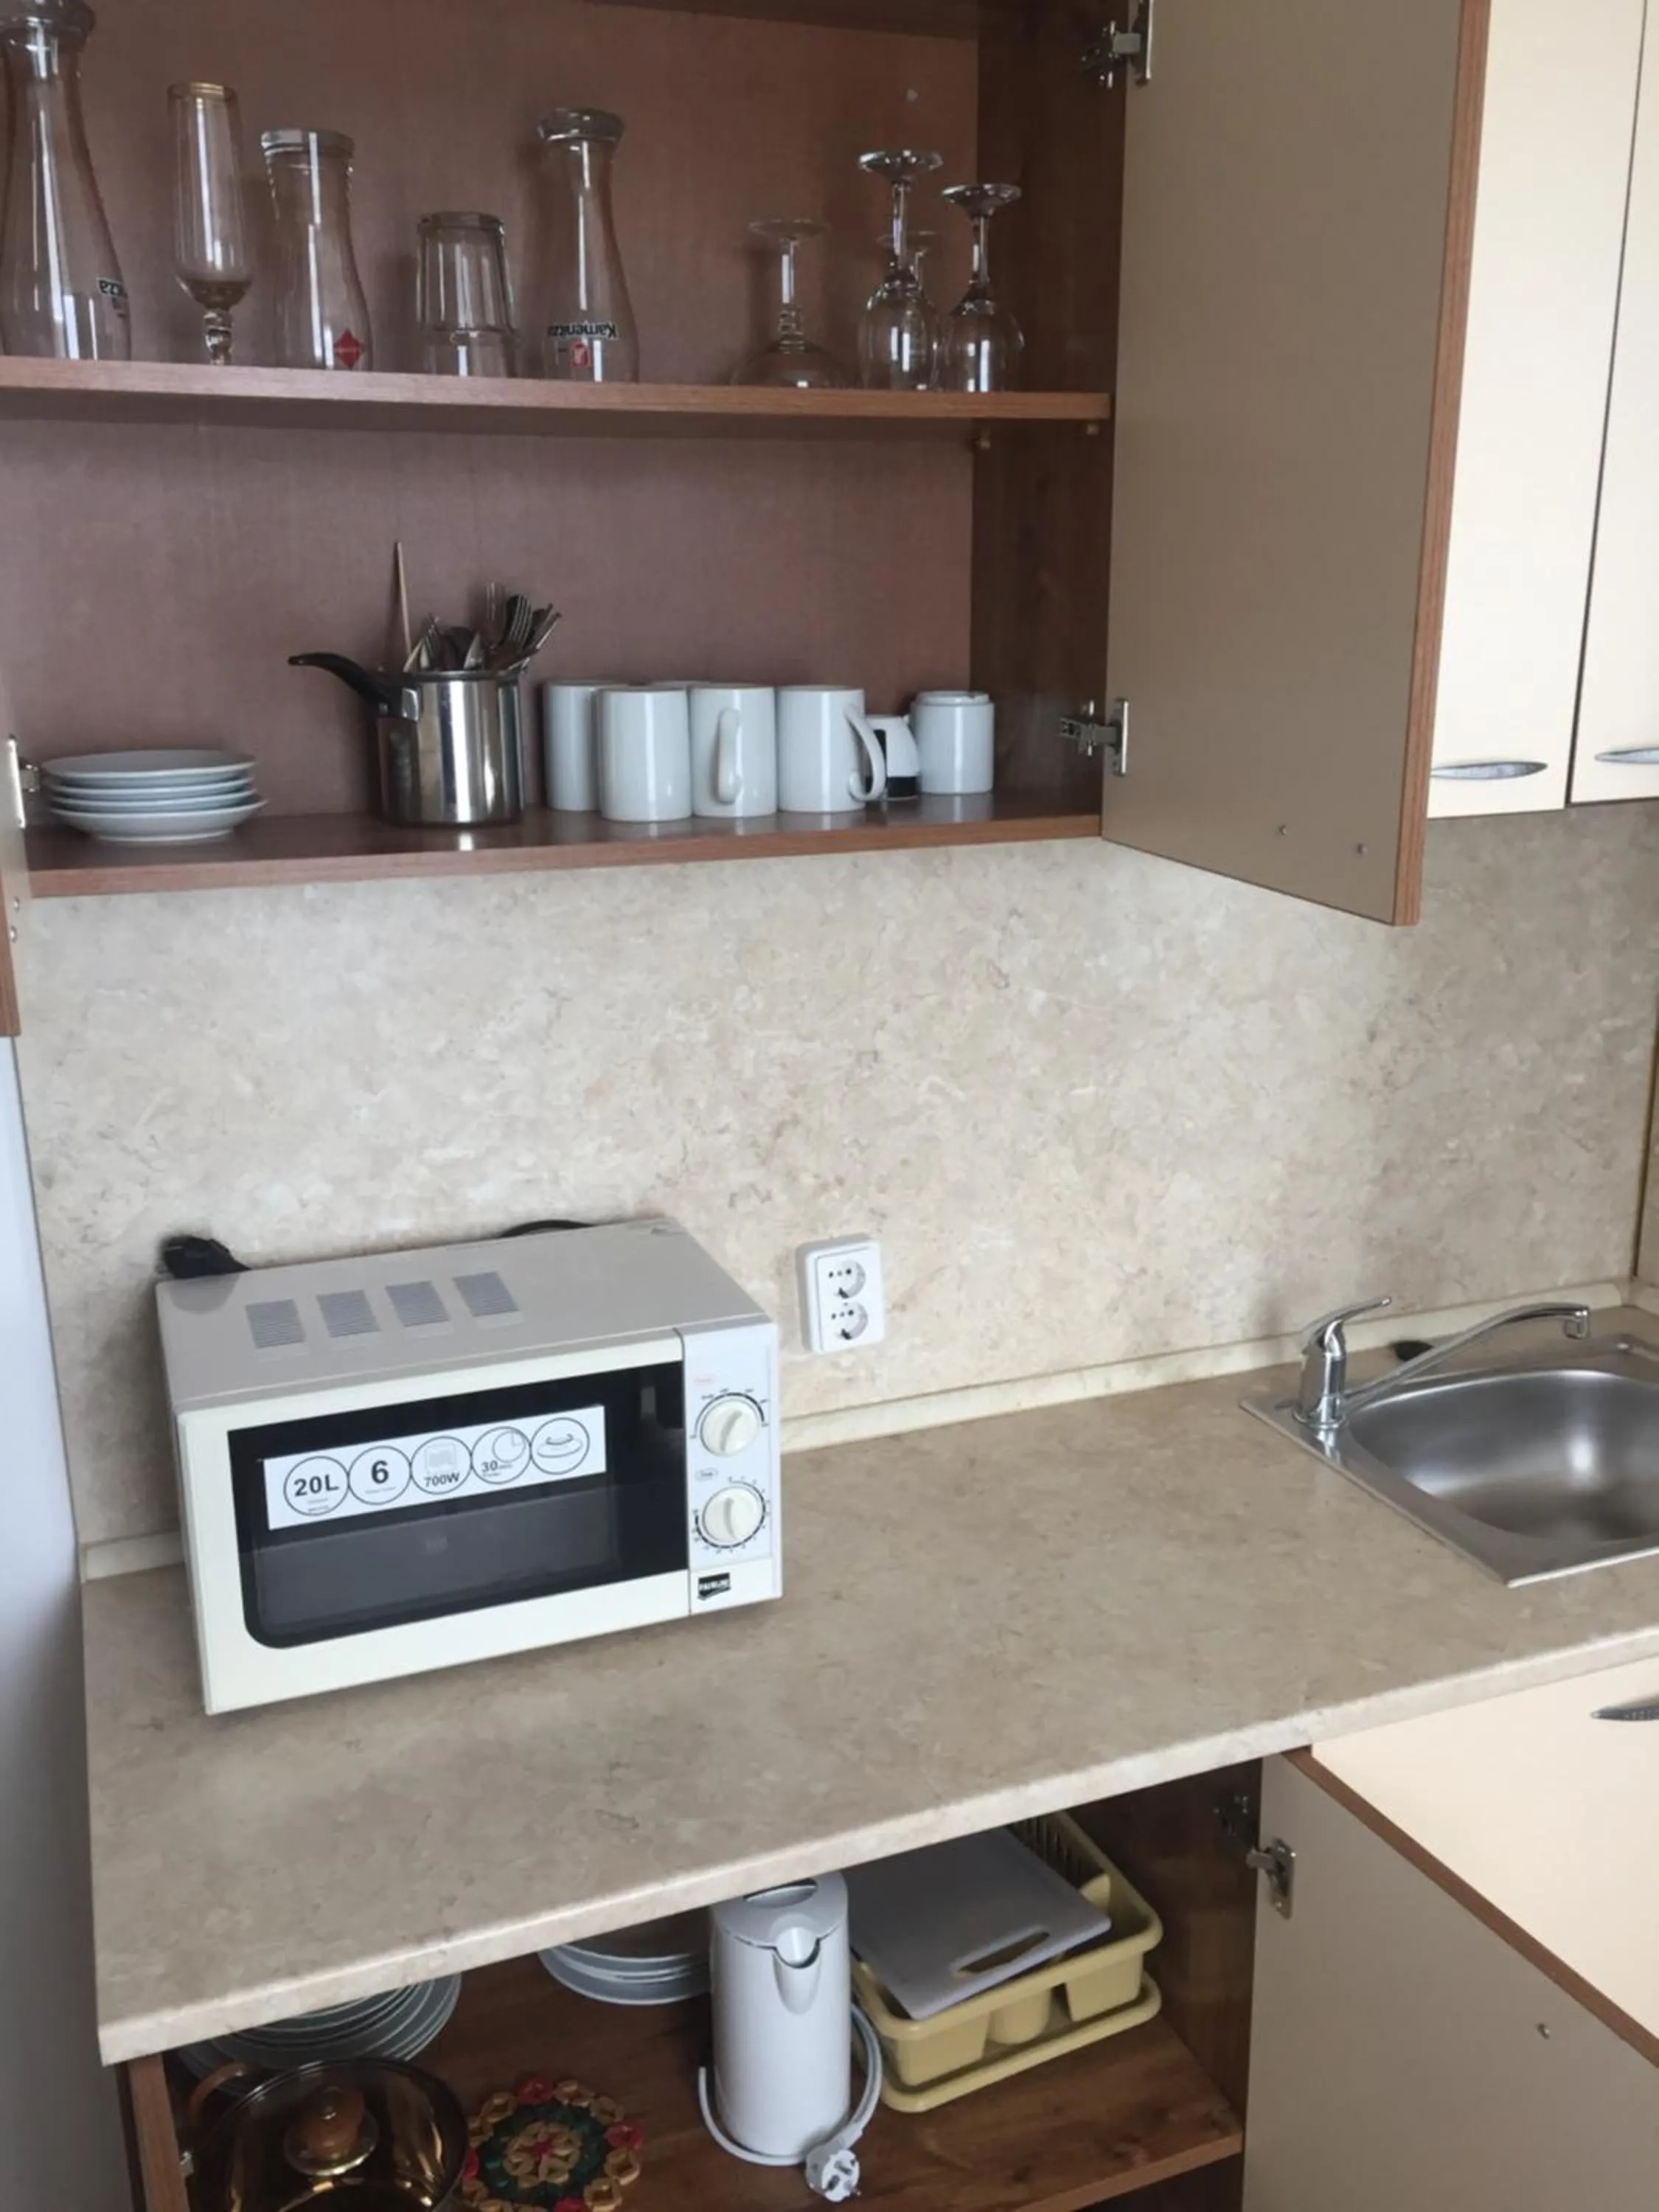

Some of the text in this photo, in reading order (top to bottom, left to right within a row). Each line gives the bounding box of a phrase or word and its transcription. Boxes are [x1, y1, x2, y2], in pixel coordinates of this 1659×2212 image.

[371, 1460, 389, 1484] 6
[481, 1459, 498, 1473] 30
[293, 1474, 340, 1497] 20L
[424, 1472, 461, 1488] 700W
